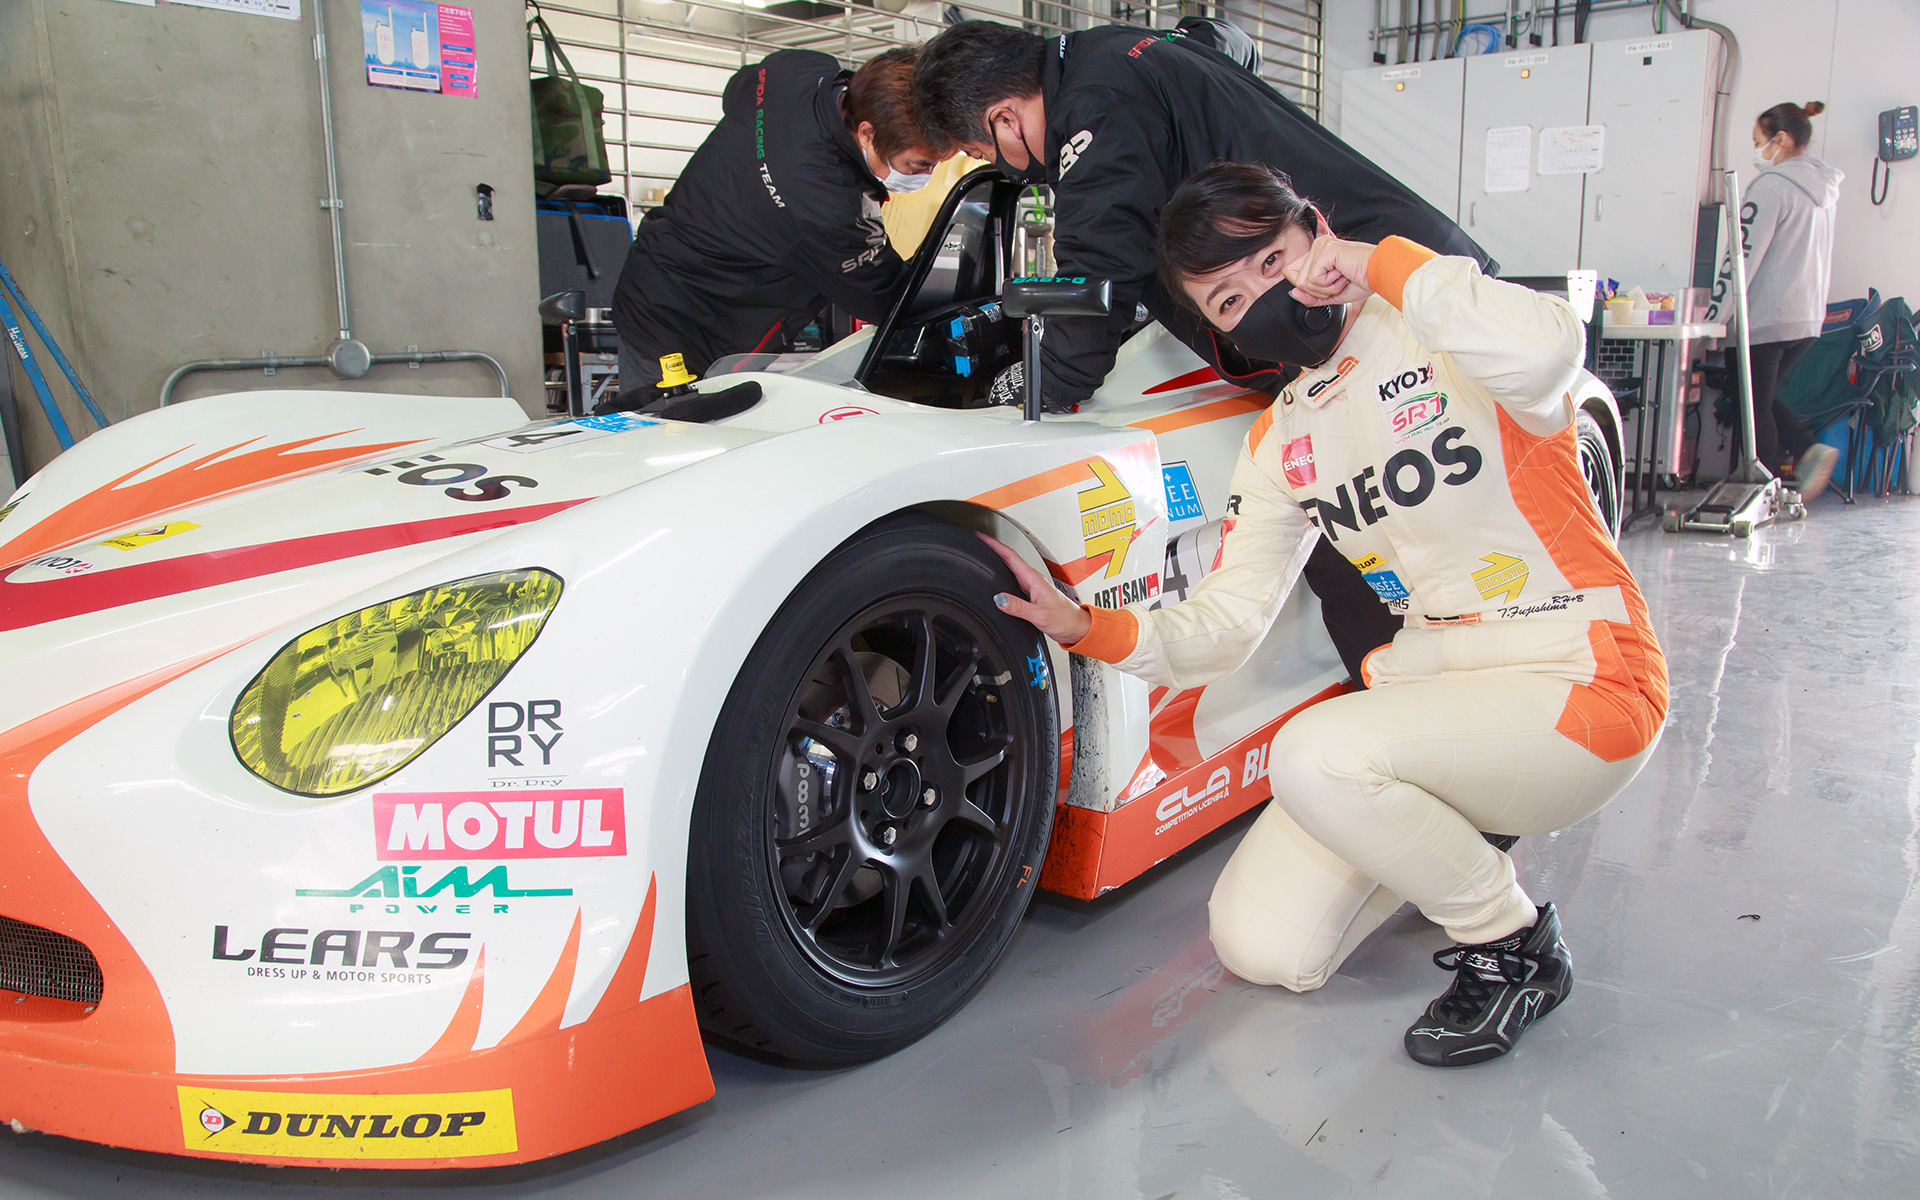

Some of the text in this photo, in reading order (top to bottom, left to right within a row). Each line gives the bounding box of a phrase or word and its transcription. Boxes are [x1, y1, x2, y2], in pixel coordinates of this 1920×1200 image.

[1627, 42, 1670, 51] PA-PIT-403
[1507, 56, 1546, 65] PA-PIT-203
[756, 68, 786, 208] SFIDA RACING TEAM
[1012, 276, 1086, 284] BABY-G
[507, 430, 584, 447] 4
[1411, 425, 1435, 437] RACING
[1283, 453, 1315, 472] ENEO
[1081, 500, 1136, 547] momo
[1475, 561, 1529, 592] momo
[1094, 576, 1148, 610] ARTISAN
[1497, 602, 1567, 618] T.Fujishima
[488, 699, 564, 733] DR
[488, 732, 565, 767] RY
[525, 779, 563, 787] Dry
[1156, 766, 1231, 821] CLA
[387, 799, 614, 851] MOTUL
[1155, 806, 1198, 836] COMPETITION
[1198, 790, 1224, 811] LICENSE
[349, 904, 510, 914] POWER
[212, 925, 472, 969] LEARS
[247, 967, 432, 984] DRESS UP & MOTOR SPORTS
[242, 1111, 486, 1138] DUNLOP
